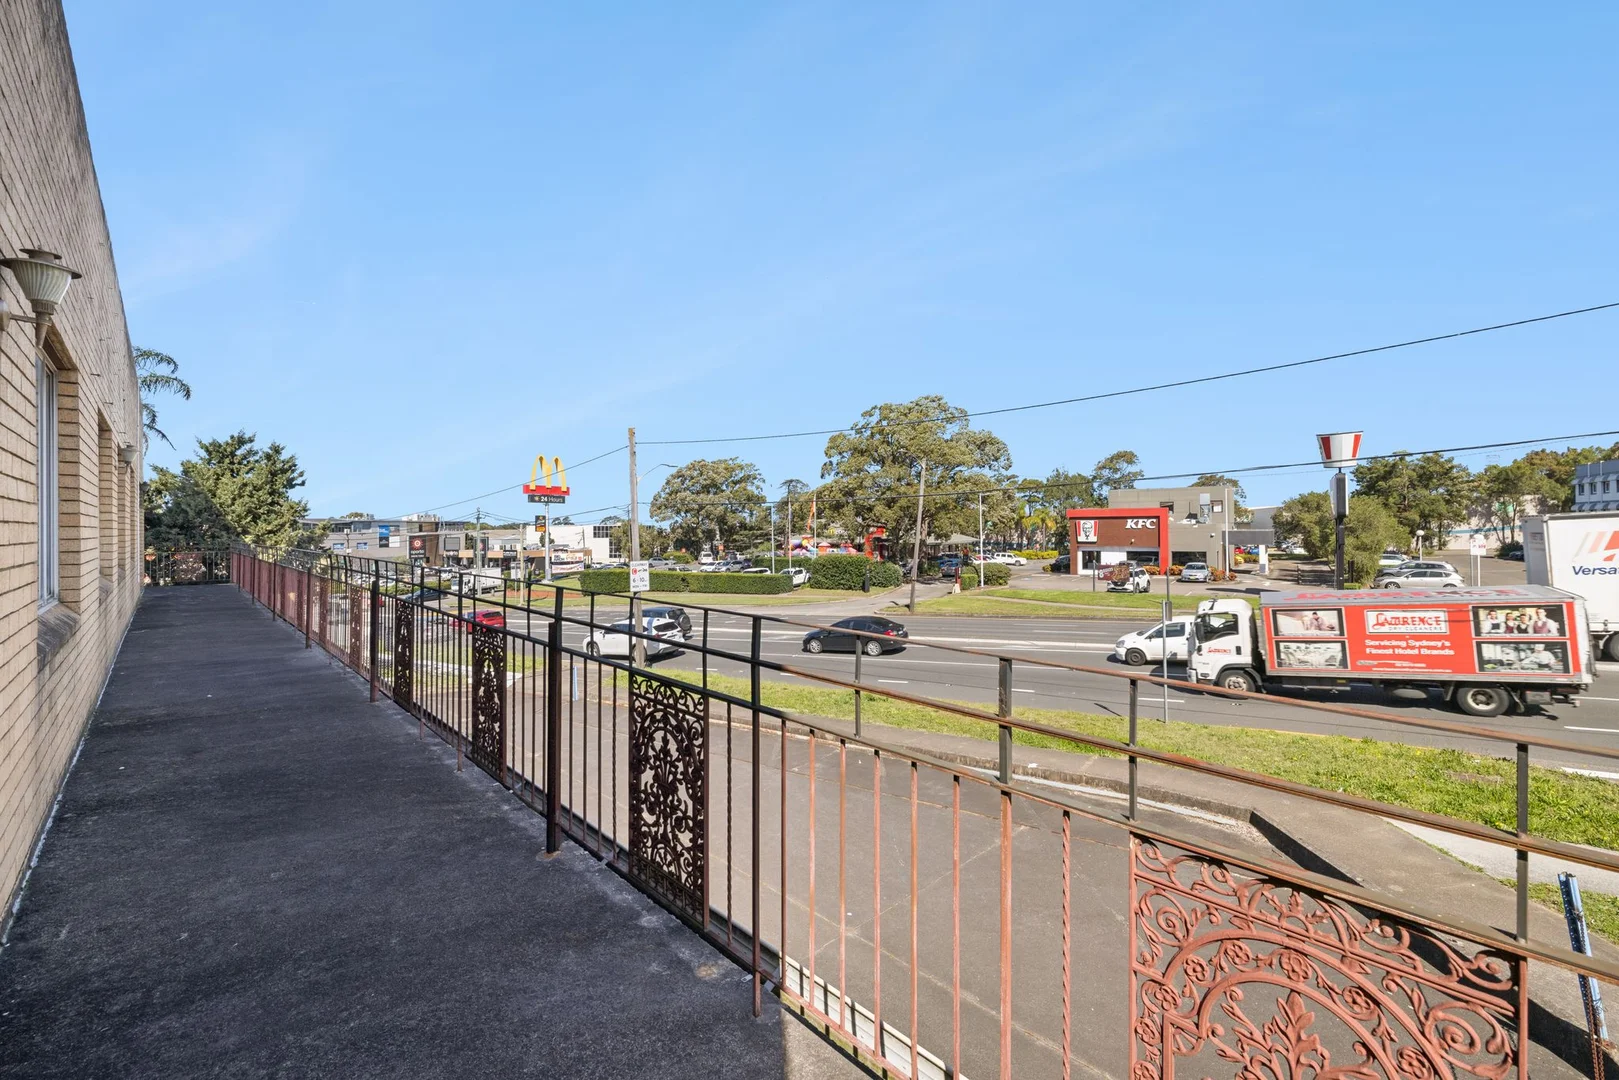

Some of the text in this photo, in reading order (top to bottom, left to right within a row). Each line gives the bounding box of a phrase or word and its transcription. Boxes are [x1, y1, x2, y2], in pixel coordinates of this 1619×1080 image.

[1125, 519, 1156, 529] KFC
[1572, 565, 1619, 576] Versa
[1365, 640, 1451, 648] Servicing Sydney's
